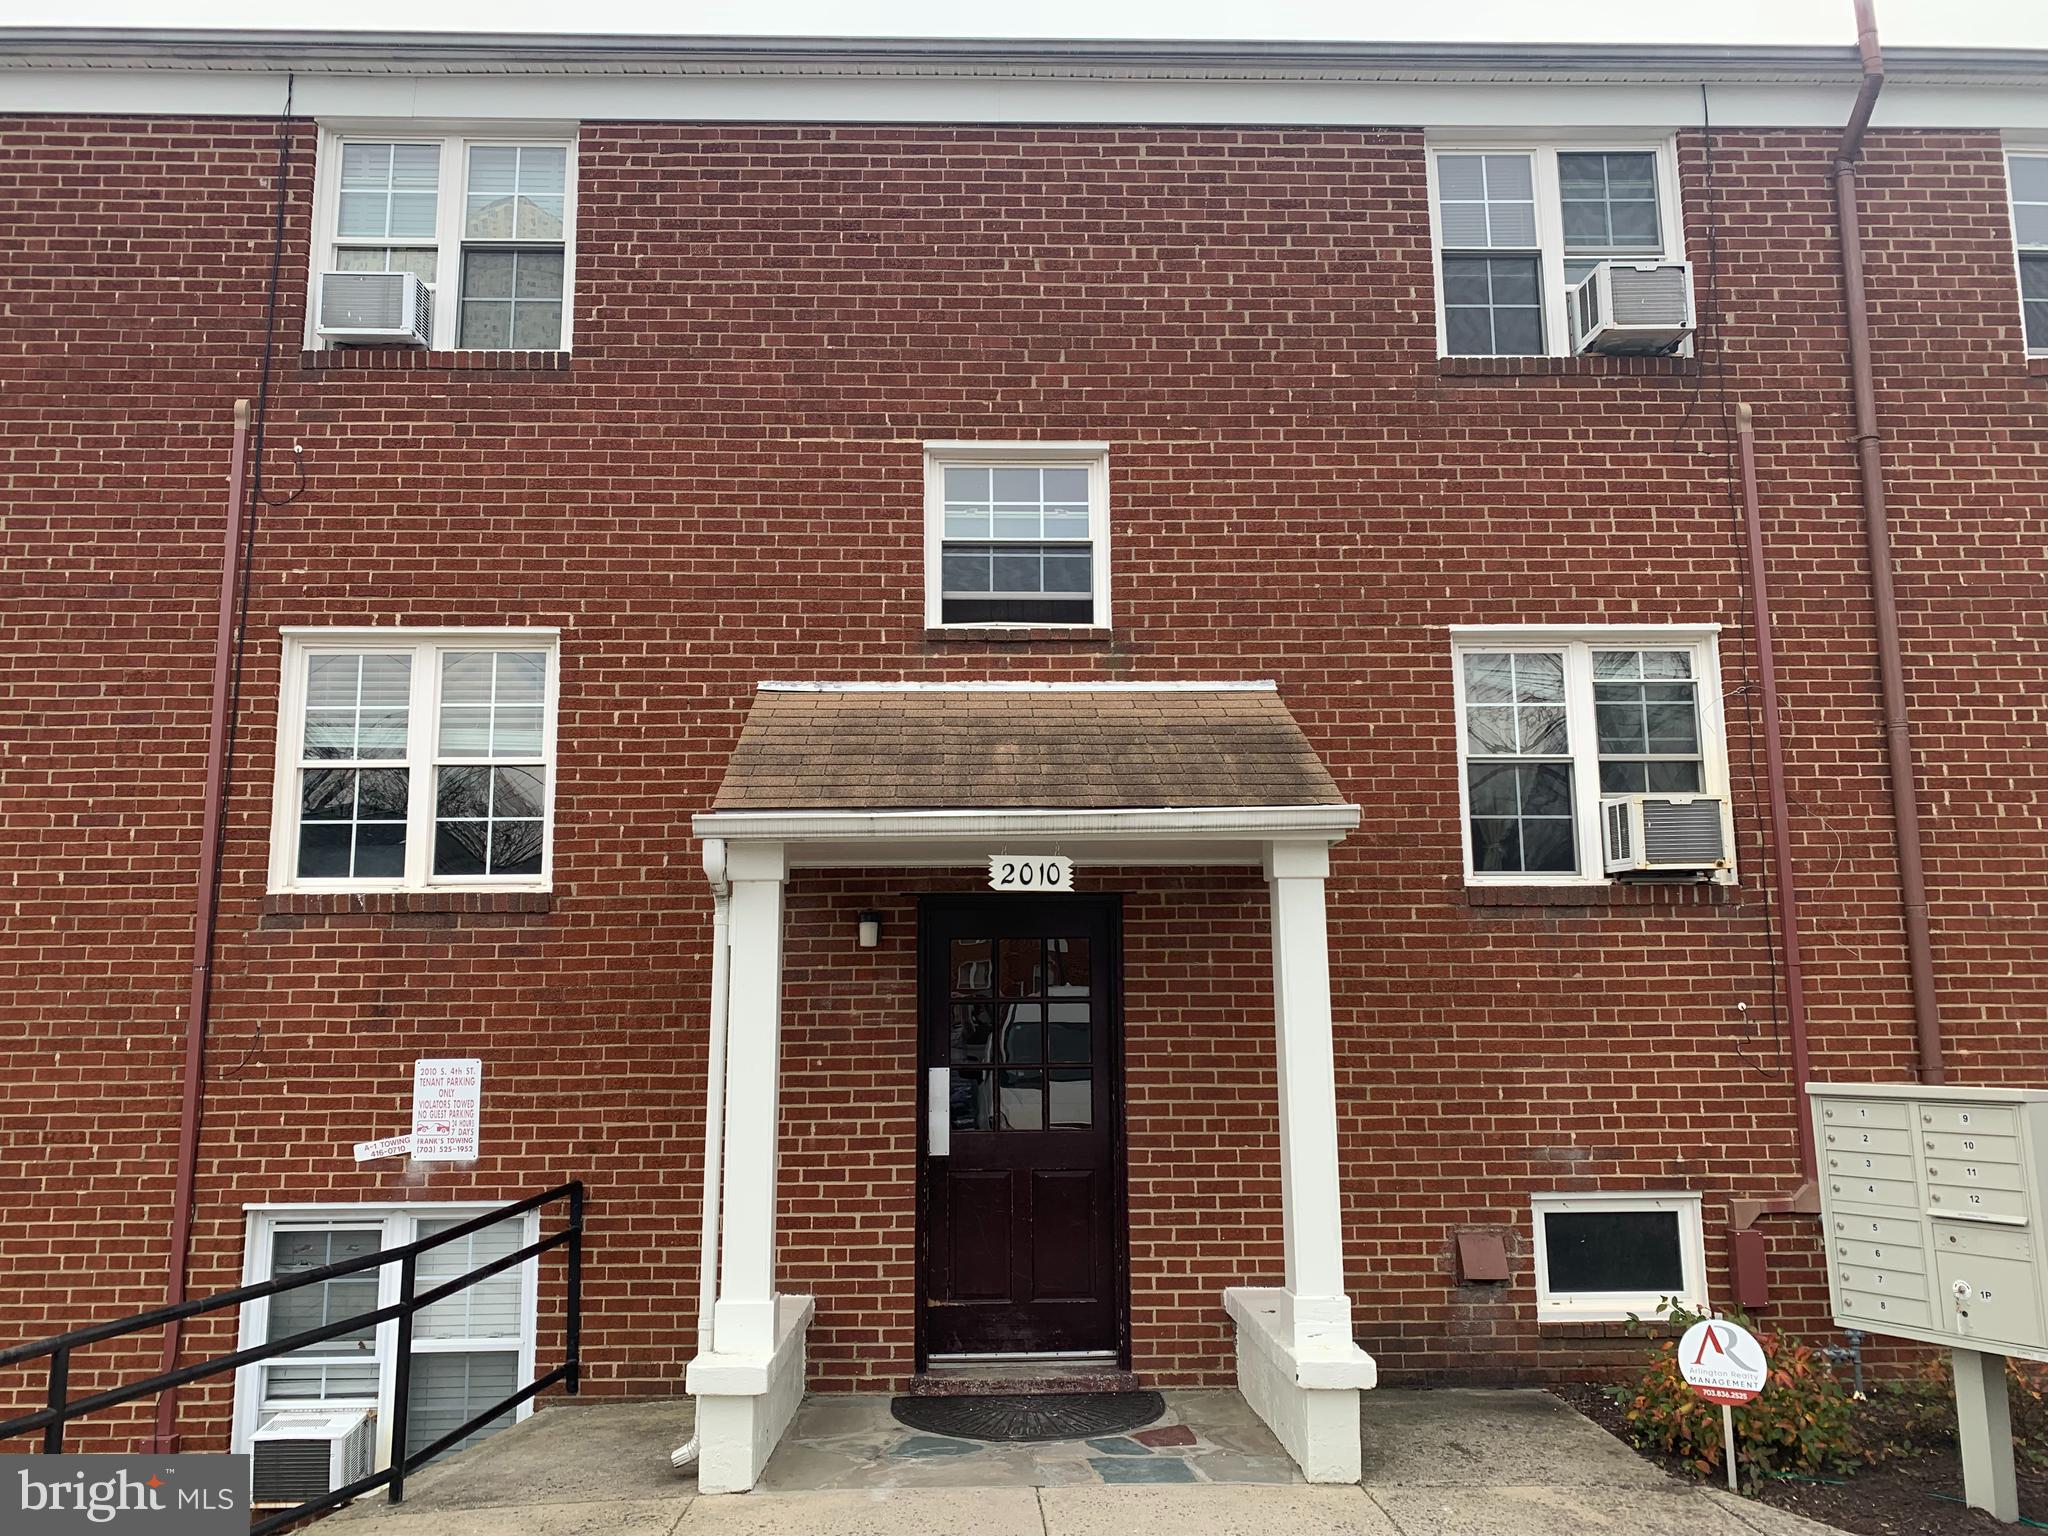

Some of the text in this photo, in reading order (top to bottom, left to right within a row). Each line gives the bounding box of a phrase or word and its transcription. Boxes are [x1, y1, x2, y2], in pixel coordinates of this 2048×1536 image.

[1001, 862, 1060, 886] 2010
[420, 1068, 436, 1076] 2010
[466, 1067, 476, 1075] ST.
[420, 1078, 476, 1086] TENANT PARKING
[438, 1089, 455, 1098] ONLY
[419, 1100, 474, 1109] VIOLATORS TOWED
[418, 1110, 474, 1119] NO GUEST PARKING
[451, 1128, 455, 1136] 7
[381, 1137, 410, 1148] TOWING
[370, 1146, 406, 1157] 416-0710
[1866, 1160, 1871, 1168] 3
[1970, 1195, 1980, 1203] 12
[1980, 1291, 1991, 1299] 1P
[1881, 1302, 1886, 1310] 8
[1689, 1367, 1759, 1380] Arlington Realty
[1690, 1376, 1758, 1388] MANAGEMENT
[1702, 1389, 1748, 1400] 703.836.2525
